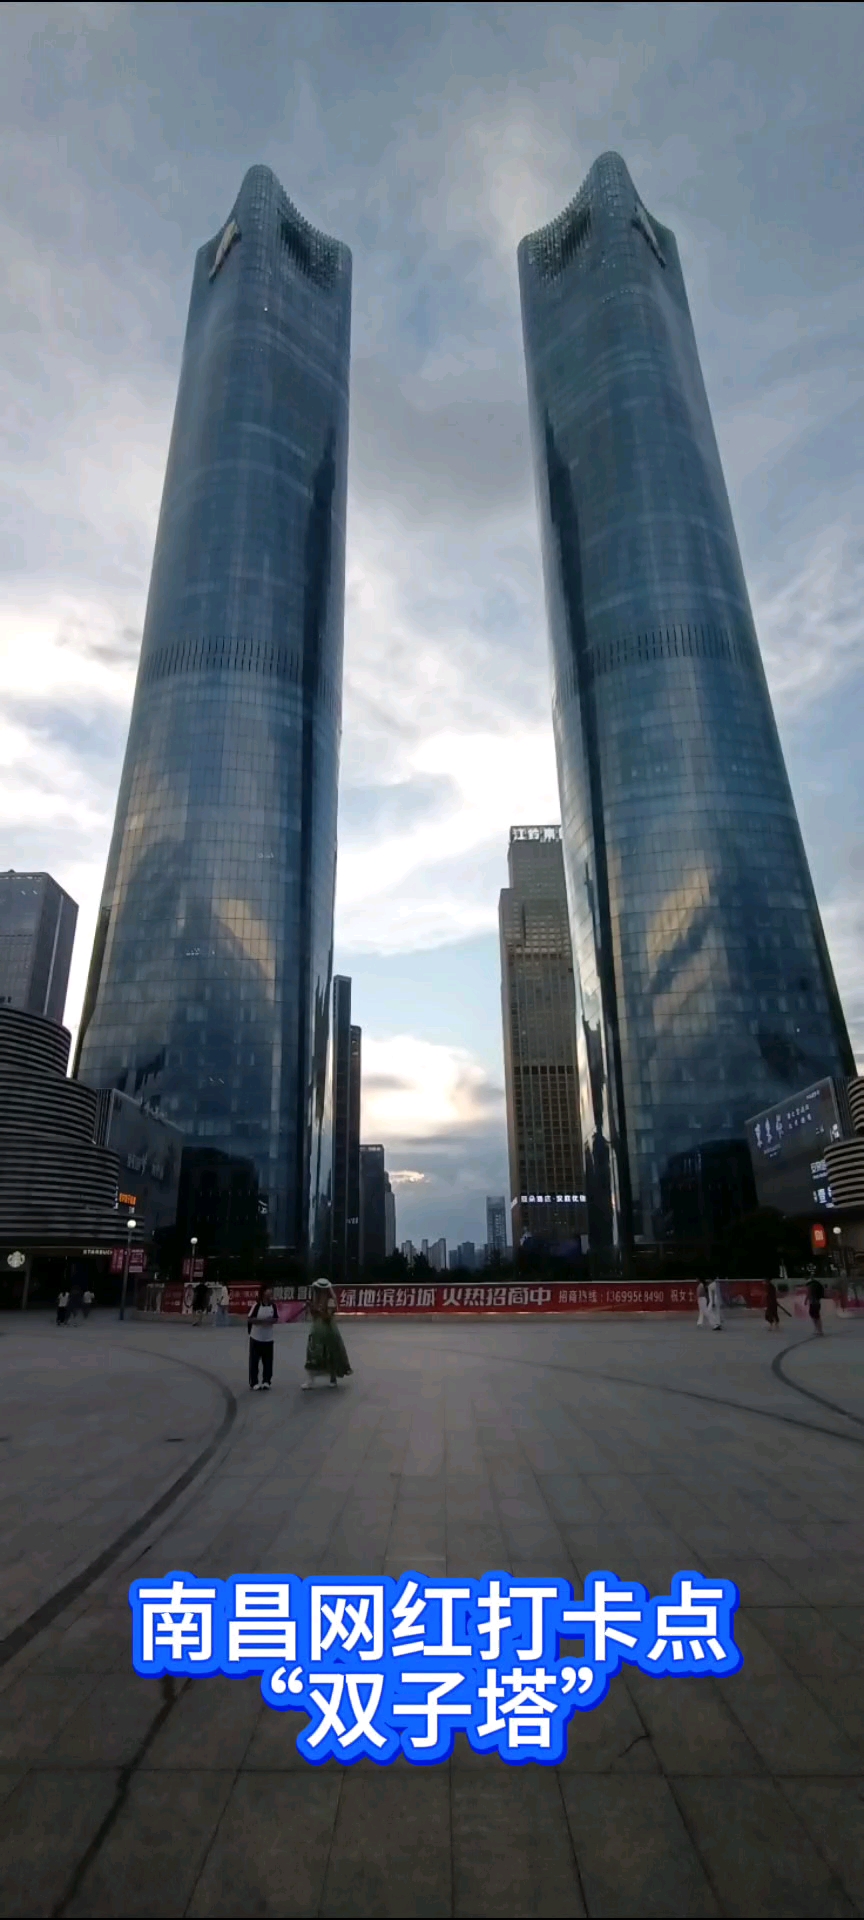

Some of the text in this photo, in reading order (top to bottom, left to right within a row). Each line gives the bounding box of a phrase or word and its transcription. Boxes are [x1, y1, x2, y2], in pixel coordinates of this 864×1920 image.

[339, 1286, 552, 1307] 绿地缤纷城 火热招商中
